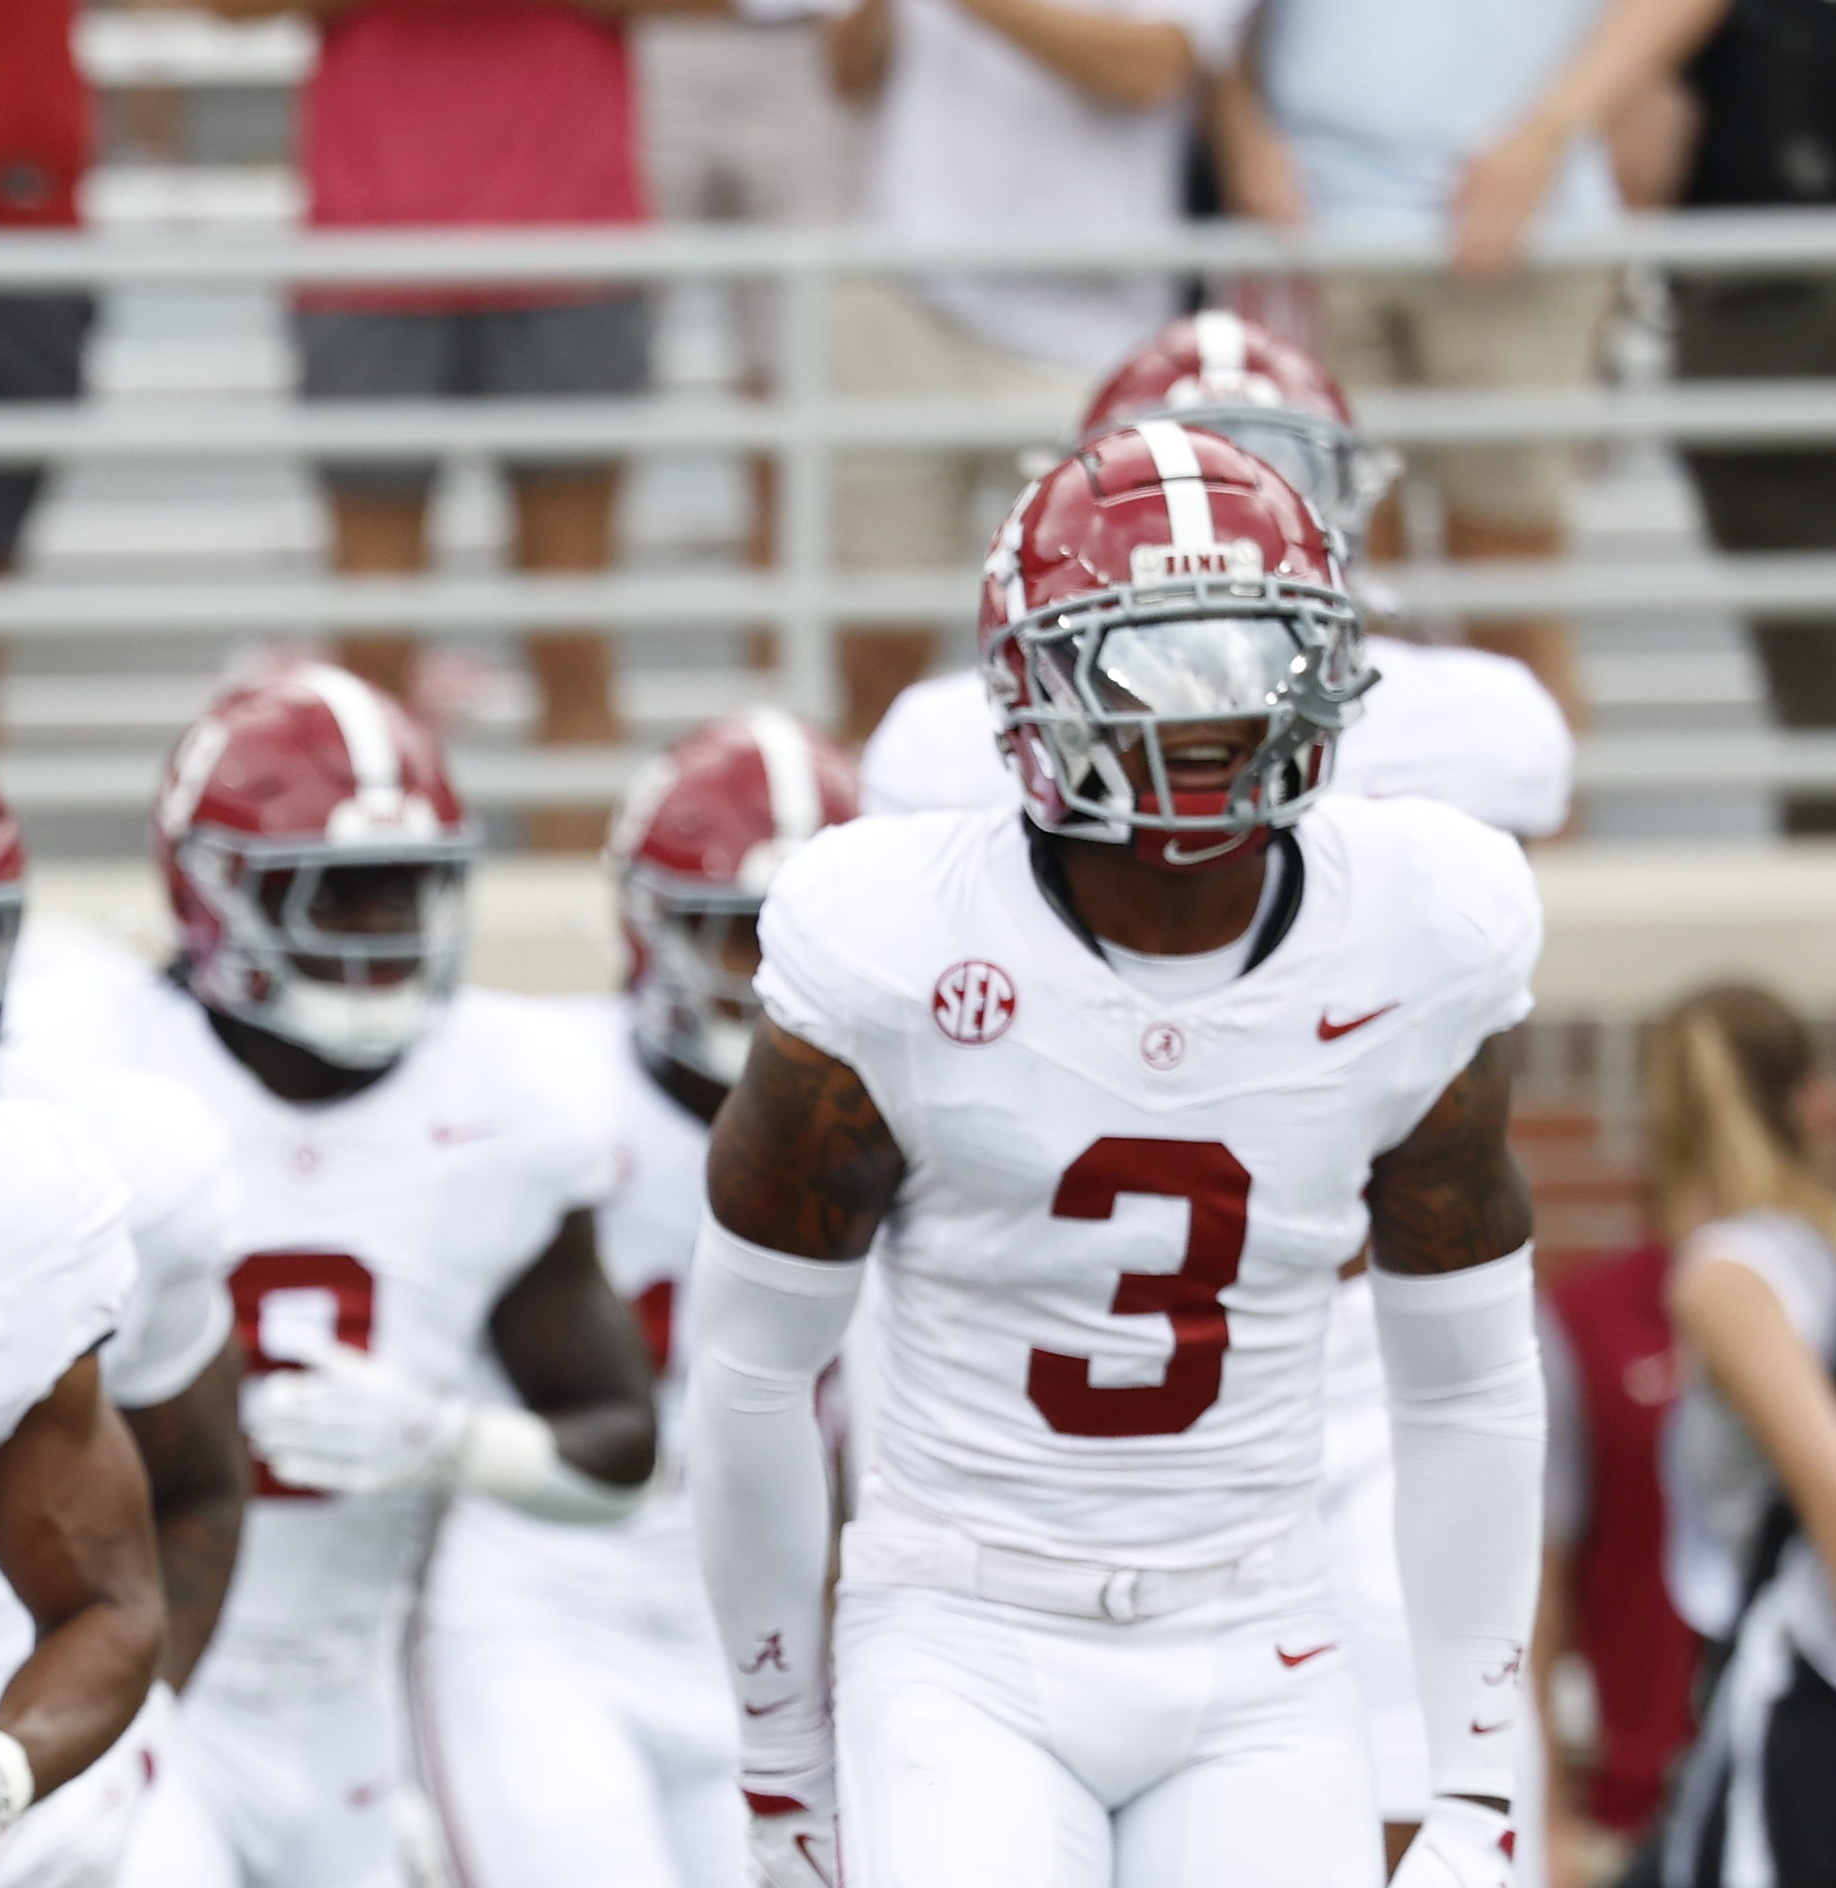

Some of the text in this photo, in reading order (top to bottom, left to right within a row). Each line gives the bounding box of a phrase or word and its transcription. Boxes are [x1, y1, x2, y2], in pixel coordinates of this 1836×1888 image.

[933, 962, 1016, 1043] SEC
[1027, 1137, 1253, 1438] 3
[740, 1631, 791, 1676] A
